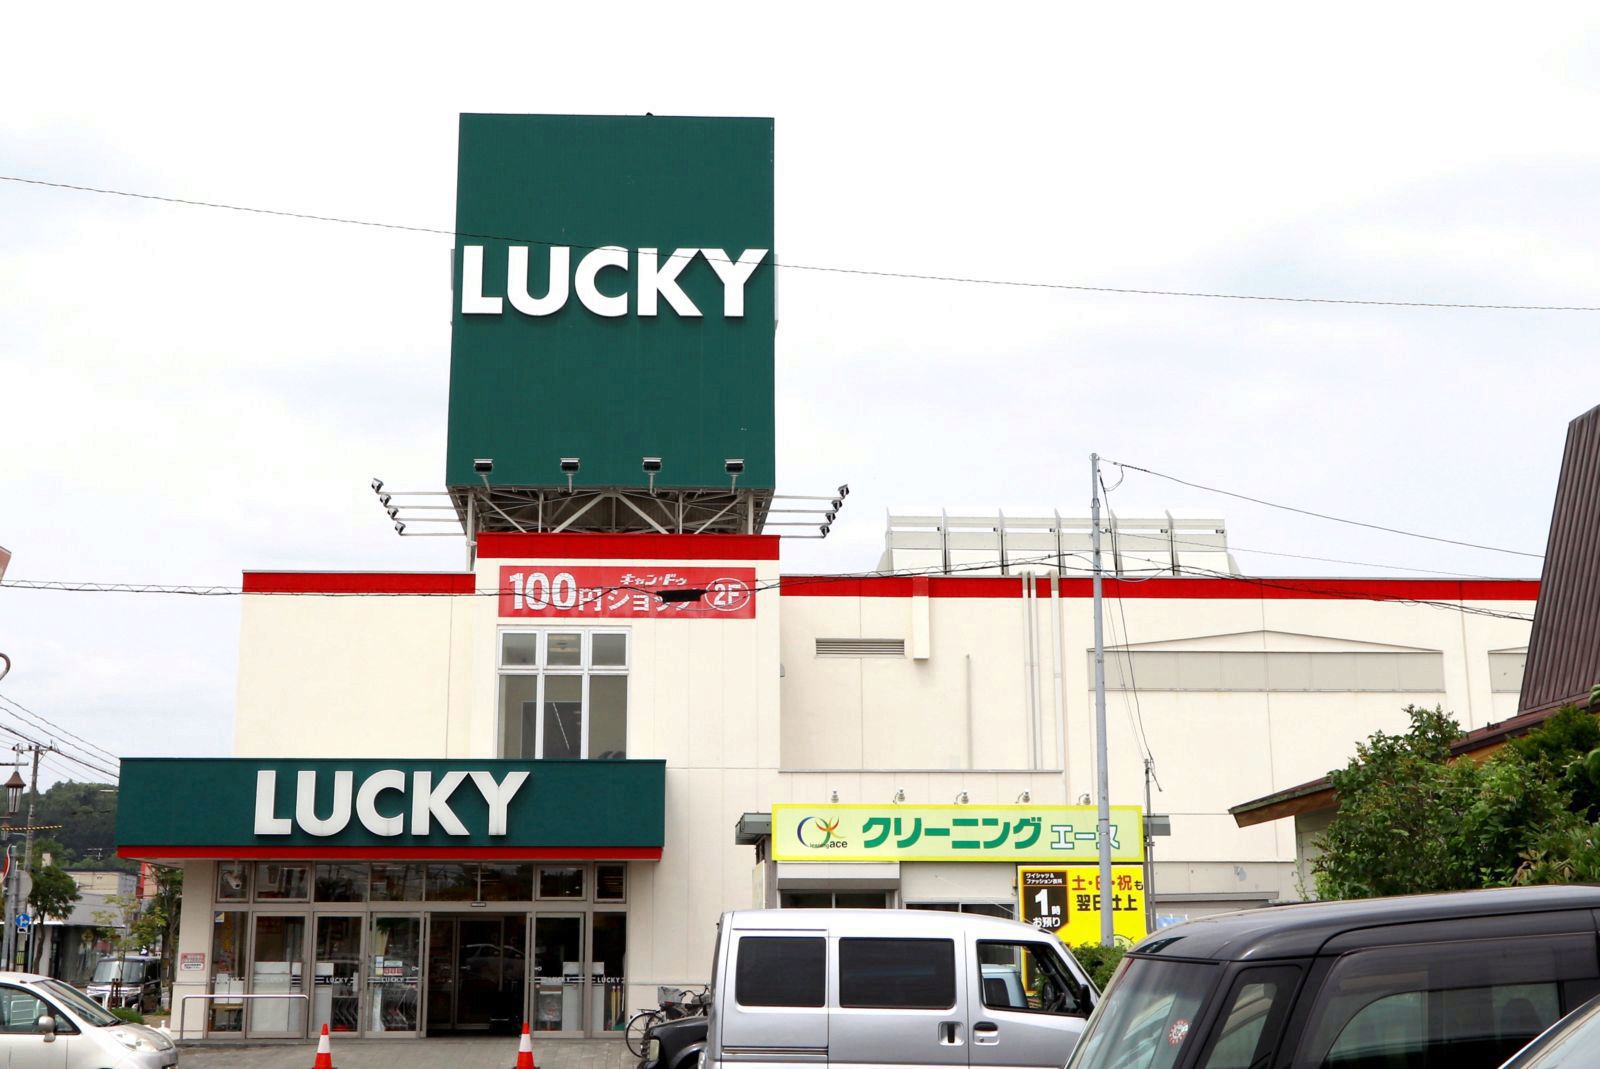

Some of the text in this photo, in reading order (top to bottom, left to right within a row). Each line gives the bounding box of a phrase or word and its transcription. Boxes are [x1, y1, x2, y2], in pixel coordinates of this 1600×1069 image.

[461, 245, 769, 317] LUCKY
[714, 583, 741, 606] 2F
[254, 769, 531, 837] LUCKY
[829, 840, 848, 849] ace
[862, 816, 1042, 849] クリーニング
